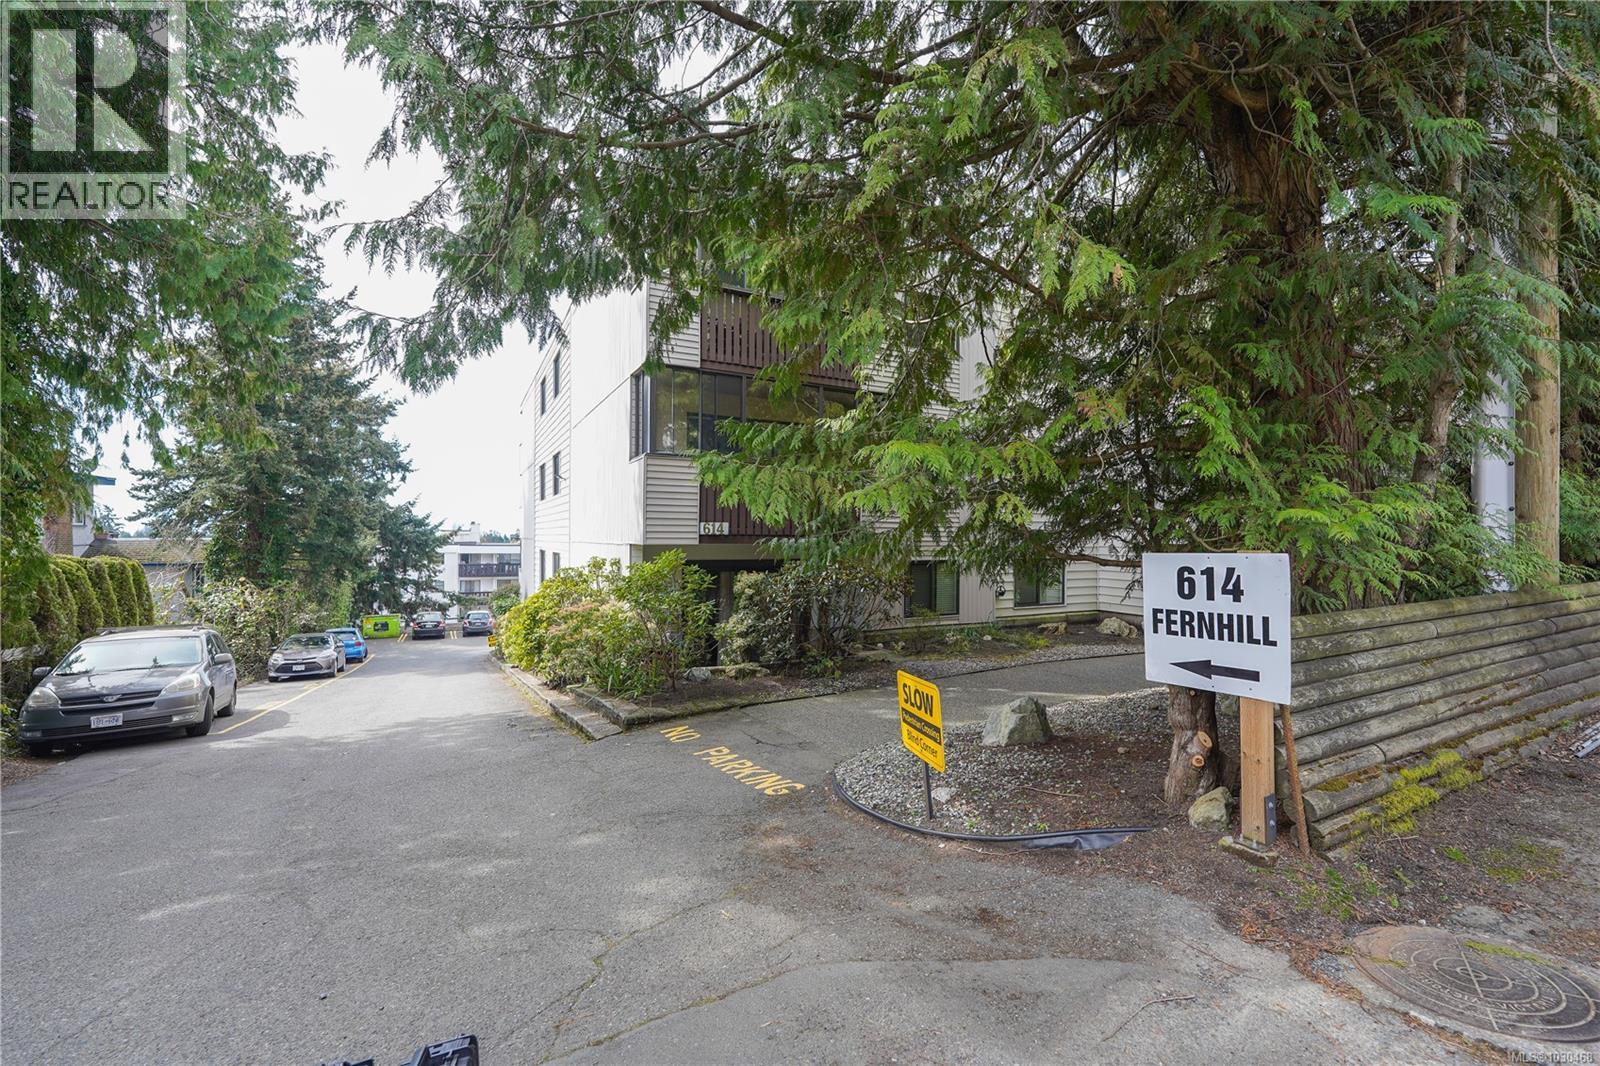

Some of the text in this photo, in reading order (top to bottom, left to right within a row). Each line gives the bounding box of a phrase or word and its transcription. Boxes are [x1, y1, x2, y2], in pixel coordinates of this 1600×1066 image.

[703, 523, 724, 534] 614
[1176, 565, 1244, 602] 614
[1152, 607, 1278, 647] FERNHILL
[902, 682, 934, 717] SLOW
[660, 725, 806, 795] NO PARKING
